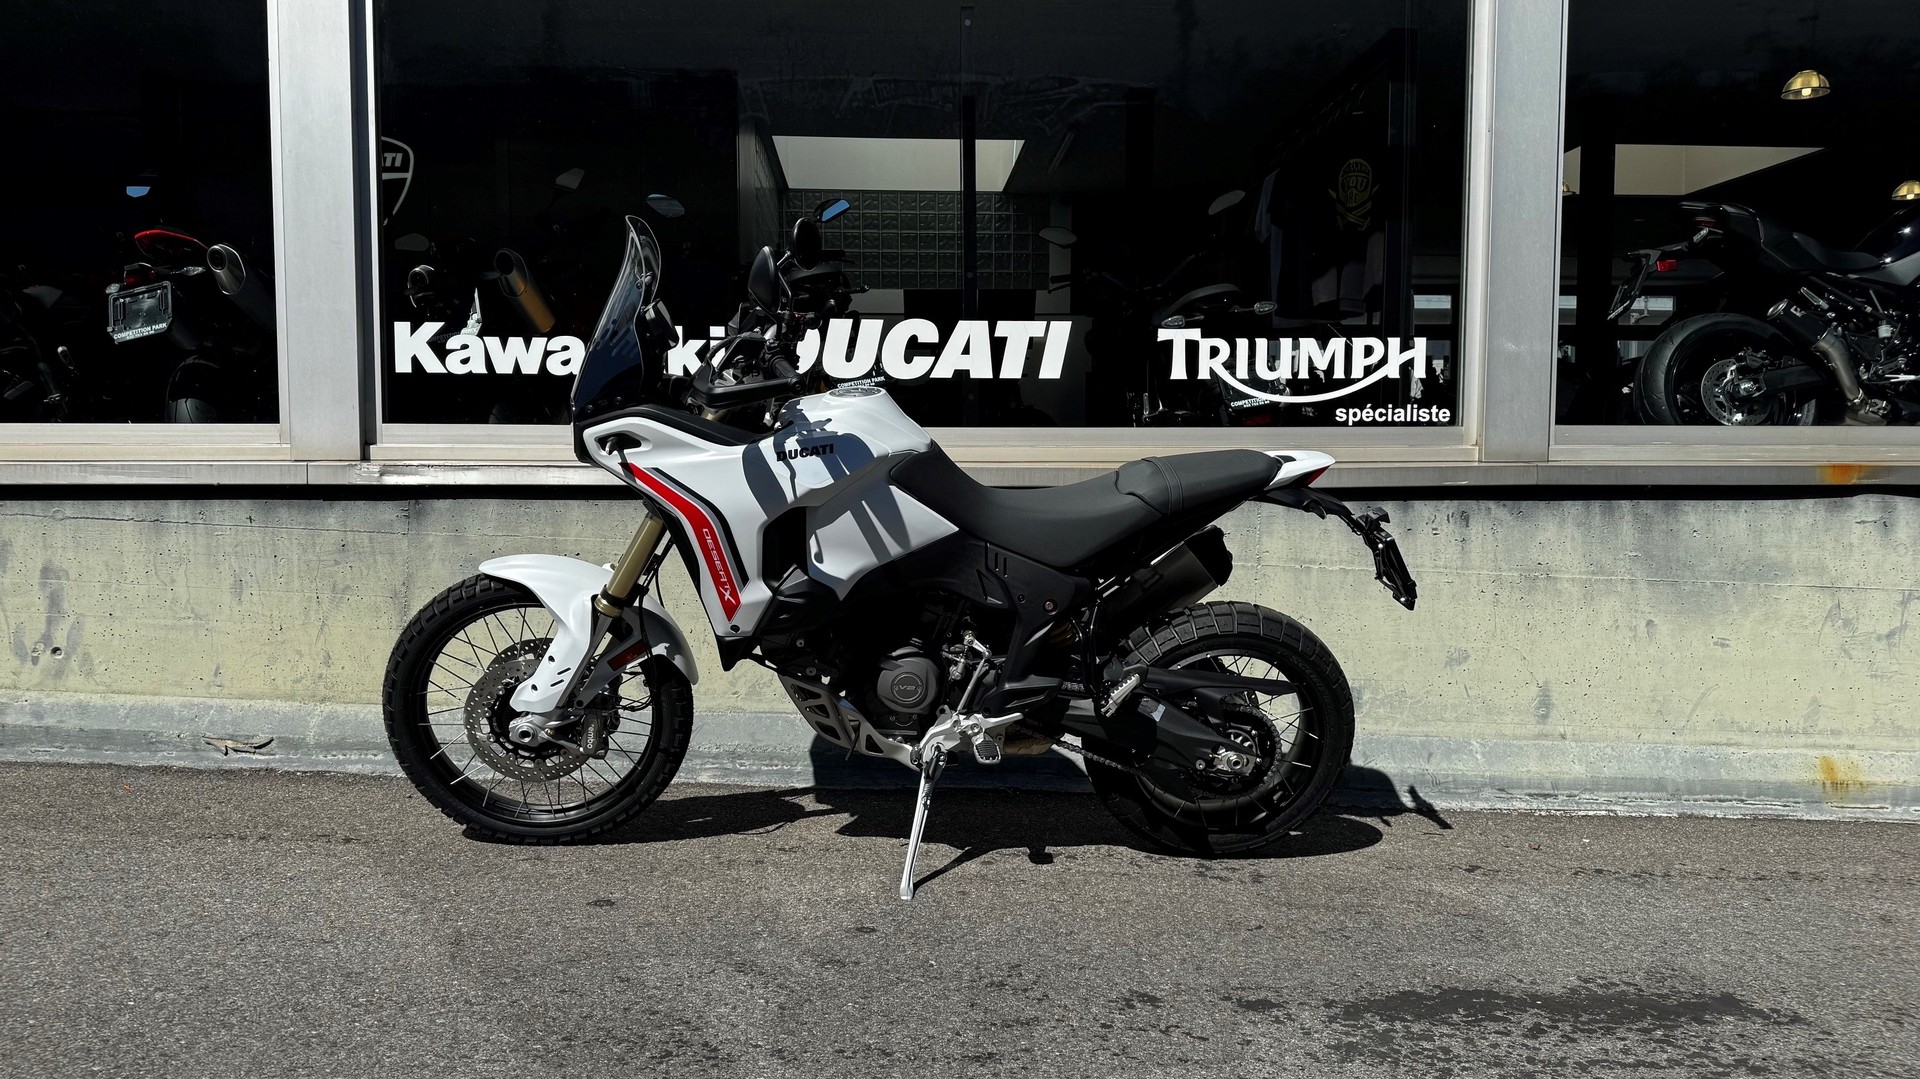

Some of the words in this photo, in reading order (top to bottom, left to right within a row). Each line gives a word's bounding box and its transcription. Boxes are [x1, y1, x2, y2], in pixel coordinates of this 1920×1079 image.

[113, 325, 151, 340] COMPETITION
[152, 322, 167, 330] PARK
[393, 321, 726, 376] Kawaki
[1157, 328, 1427, 402] TRIUMPH
[1335, 404, 1451, 426] spécialiste
[776, 443, 834, 462] DUCATI
